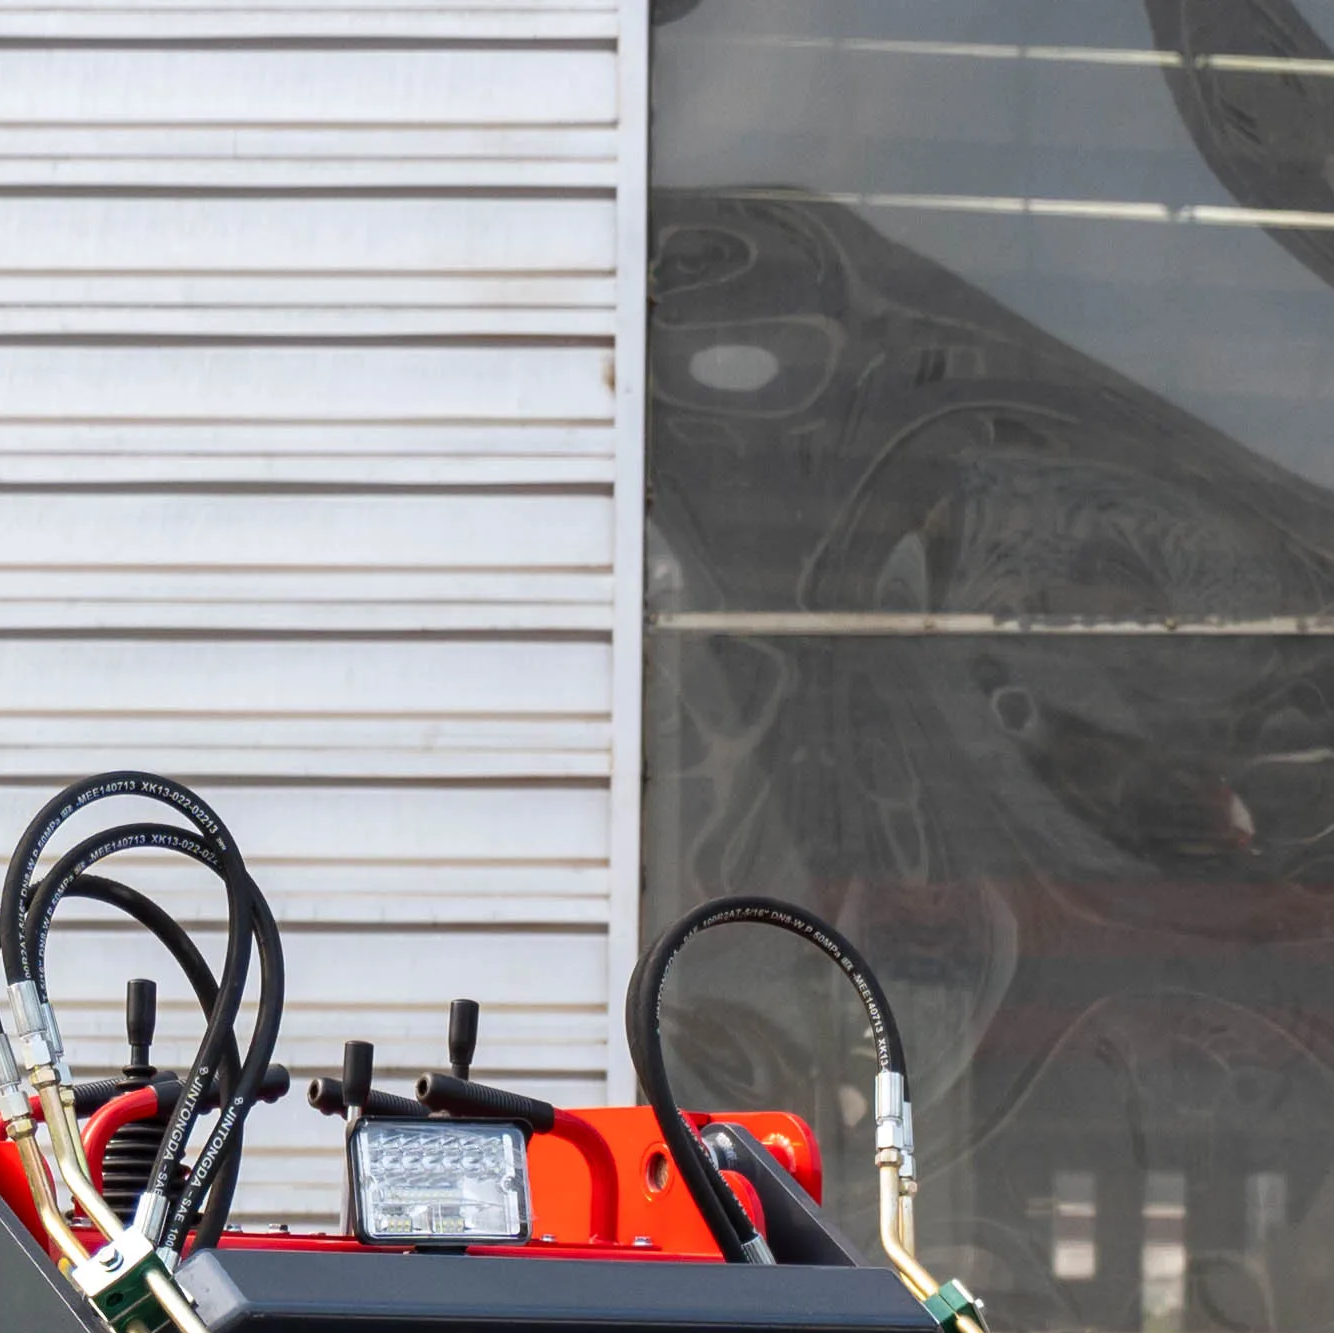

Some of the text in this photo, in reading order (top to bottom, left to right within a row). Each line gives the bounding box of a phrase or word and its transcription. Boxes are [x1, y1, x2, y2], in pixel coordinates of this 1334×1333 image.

[142, 781, 219, 834] XK13-022-02213
[163, 1077, 204, 1160] JINTONGDA
[191, 1106, 237, 1187] JINTONGDA
